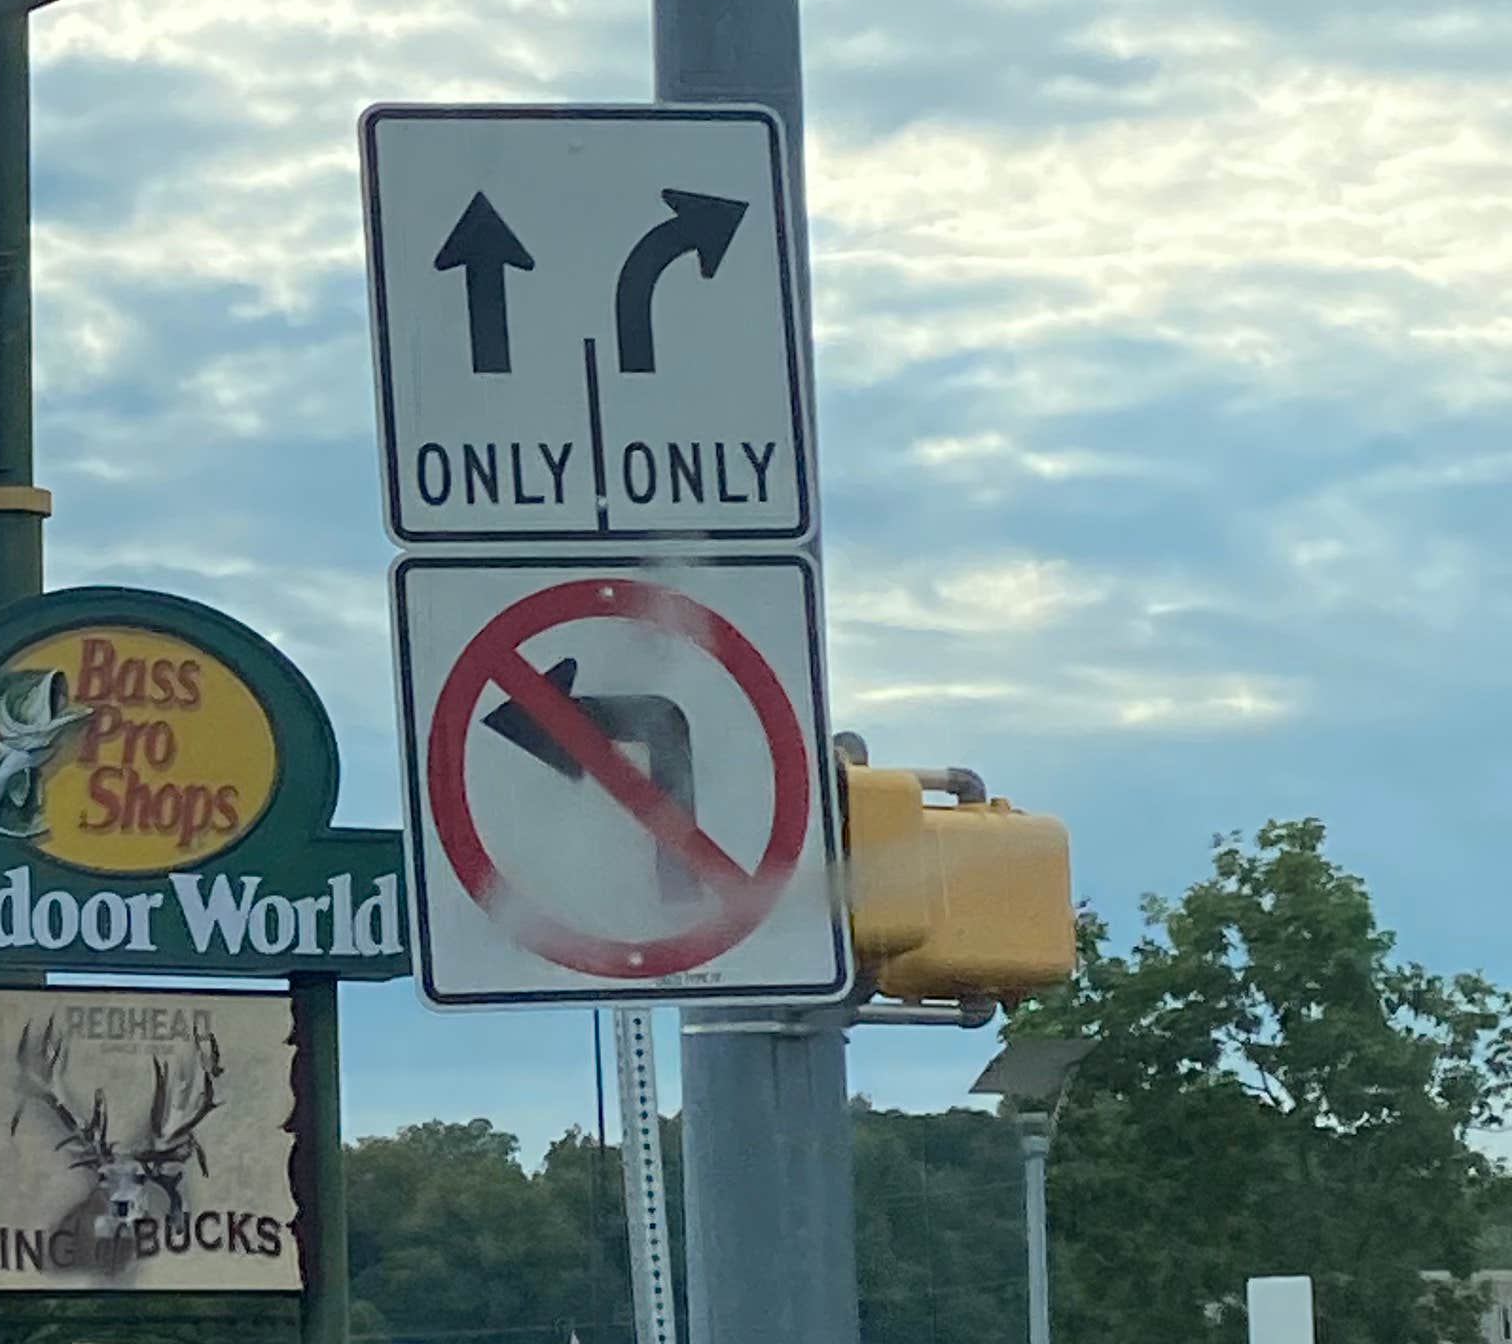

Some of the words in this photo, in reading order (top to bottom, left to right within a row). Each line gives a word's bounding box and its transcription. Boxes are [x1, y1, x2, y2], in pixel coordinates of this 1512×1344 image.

[415, 441, 574, 506] ONLY
[621, 440, 777, 505] ONLY
[74, 637, 203, 708] Bass
[78, 702, 178, 772] Pro
[79, 766, 242, 850] Shops
[169, 872, 404, 957] World
[66, 1006, 214, 1042] REDHEAD
[134, 1209, 283, 1258] BUCKS
